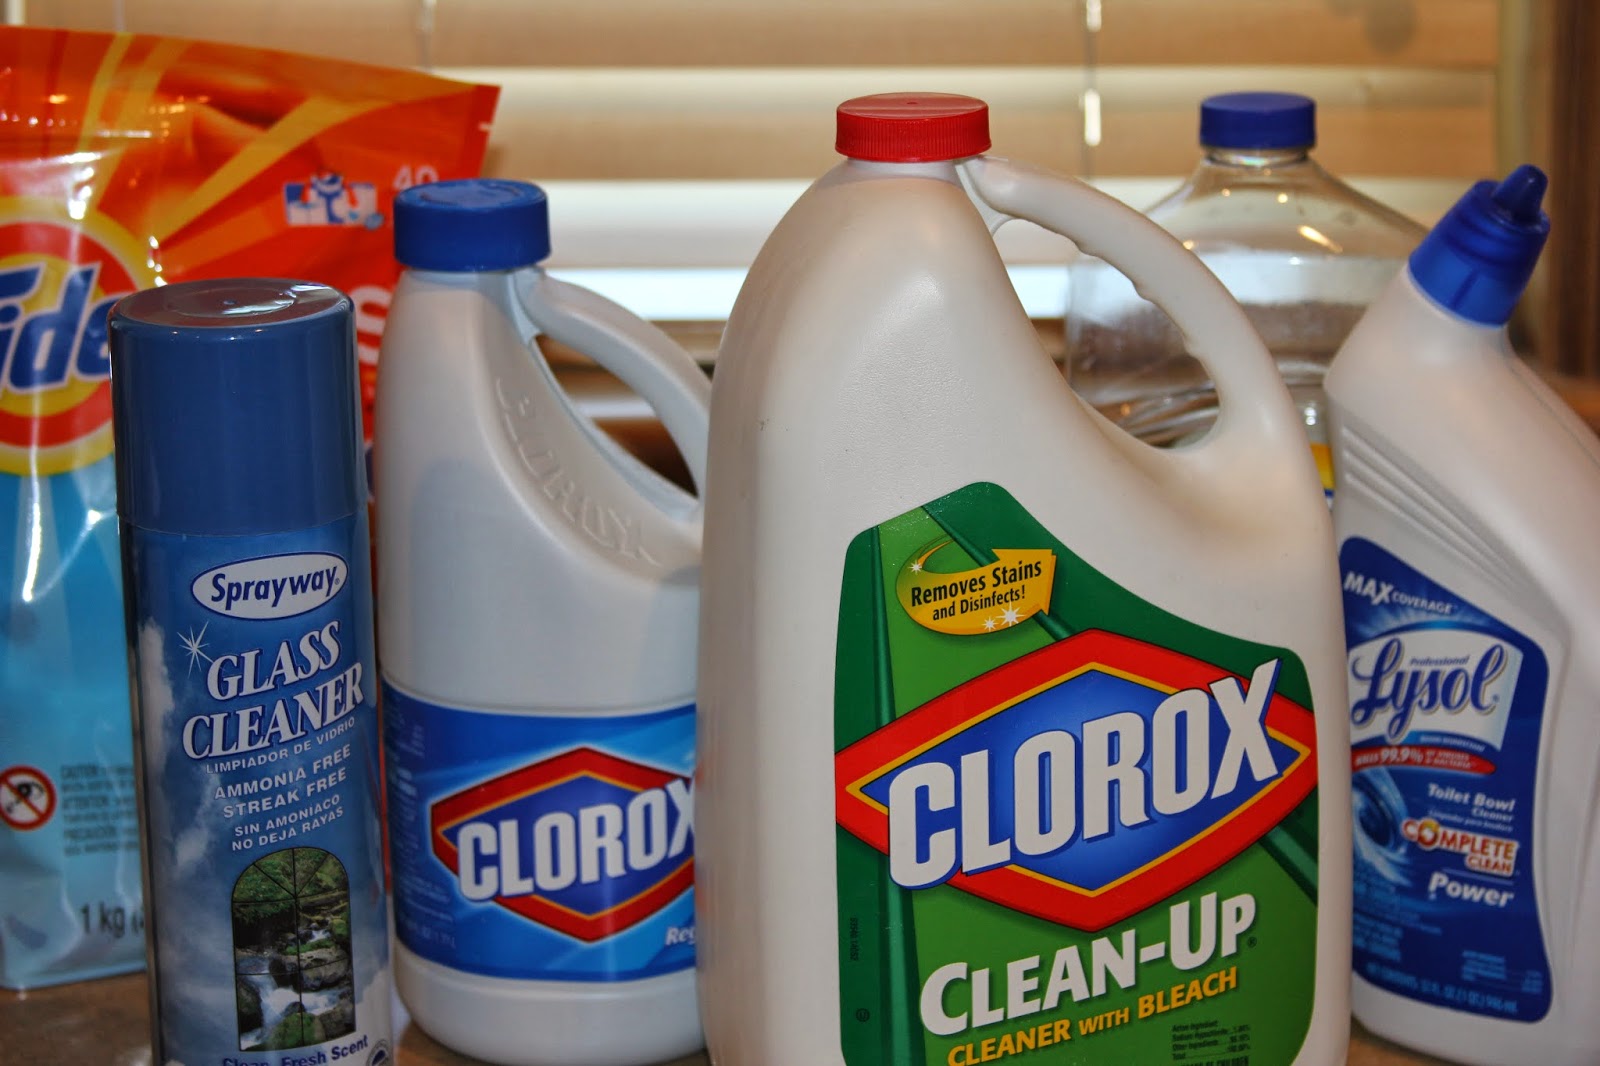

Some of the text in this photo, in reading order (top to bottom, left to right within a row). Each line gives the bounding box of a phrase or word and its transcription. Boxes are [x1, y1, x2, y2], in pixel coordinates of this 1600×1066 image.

[210, 565, 337, 610] Sprayway
[911, 560, 1042, 607] Removes Stains
[932, 584, 1026, 621] and Disinfects!
[1343, 571, 1393, 606] MAX
[206, 620, 341, 701] GLASS
[1410, 655, 1470, 667] Professional
[182, 662, 364, 760] CLEANER
[1351, 637, 1507, 741] Lysol
[206, 718, 356, 774] LIMPIADOR DE VIDRIO
[1380, 747, 1424, 763] 99.9%
[214, 744, 351, 800] AMMONIA FREE
[223, 767, 347, 819] STREAK FREE
[888, 657, 1282, 889] CLOROX
[1427, 782, 1517, 813] Toilet Bowl
[1471, 807, 1515, 823] Cleaner
[232, 806, 345, 851] NO DEJA RAYAS
[234, 822, 261, 837] SIN
[457, 771, 696, 901] CLOROX
[1402, 817, 1520, 861] COMPLETE
[1466, 854, 1513, 875] CLEAN
[1427, 871, 1516, 908] Power
[98, 900, 126, 939] kg
[919, 892, 1257, 1037] CLEAN-UP
[946, 966, 1238, 1066] CLEANER WITH BLEACH
[281, 1051, 327, 1066] Fresh
[331, 1034, 369, 1061] Scent
